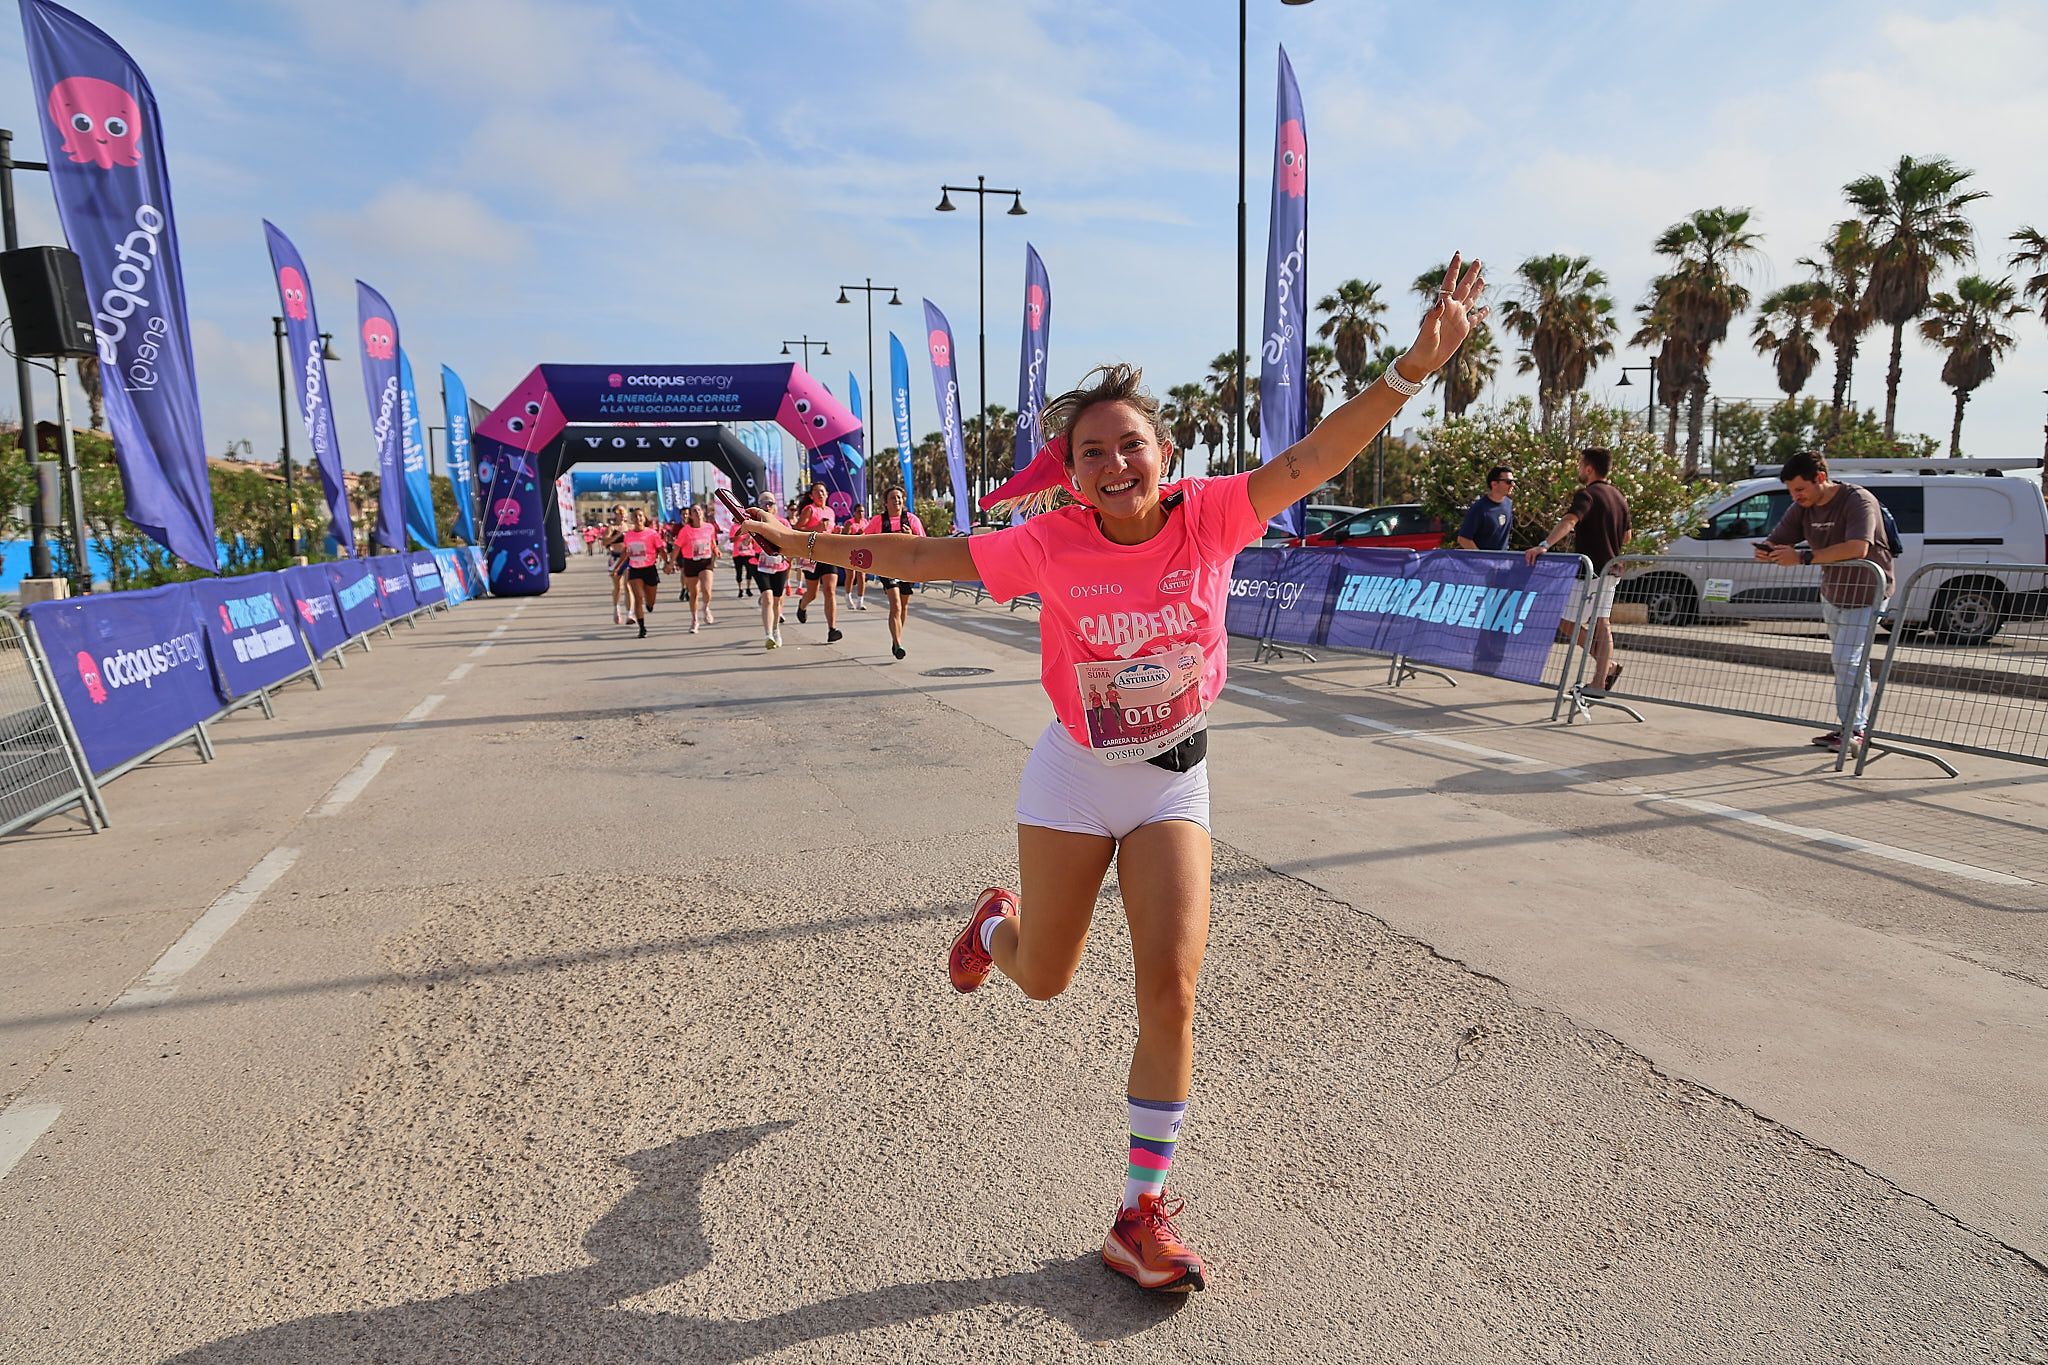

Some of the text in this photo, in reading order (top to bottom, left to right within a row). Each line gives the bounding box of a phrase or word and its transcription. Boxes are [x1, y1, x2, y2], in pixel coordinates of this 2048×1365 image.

[627, 374, 733, 389] octopus energy
[600, 392, 739, 402] LA ENERGÍA PARA CORRER
[600, 405, 608, 413] A
[610, 405, 623, 413] LA
[627, 405, 687, 413] VELOCIDAD
[721, 404, 741, 412] LUZ
[584, 437, 699, 448] VOLVO
[1070, 584, 1123, 598] OYSHO
[1248, 580, 1305, 610] energy
[1335, 574, 1538, 635] ¡ENHORABUENA!
[102, 644, 169, 689] octopus
[1087, 671, 1111, 679] SUMA
[1119, 674, 1166, 686] ASTURIANA
[1125, 703, 1172, 725] 016
[1141, 723, 1162, 735] 2725
[1102, 736, 1131, 746] CARRERA
[1106, 748, 1144, 761] OYSHO
